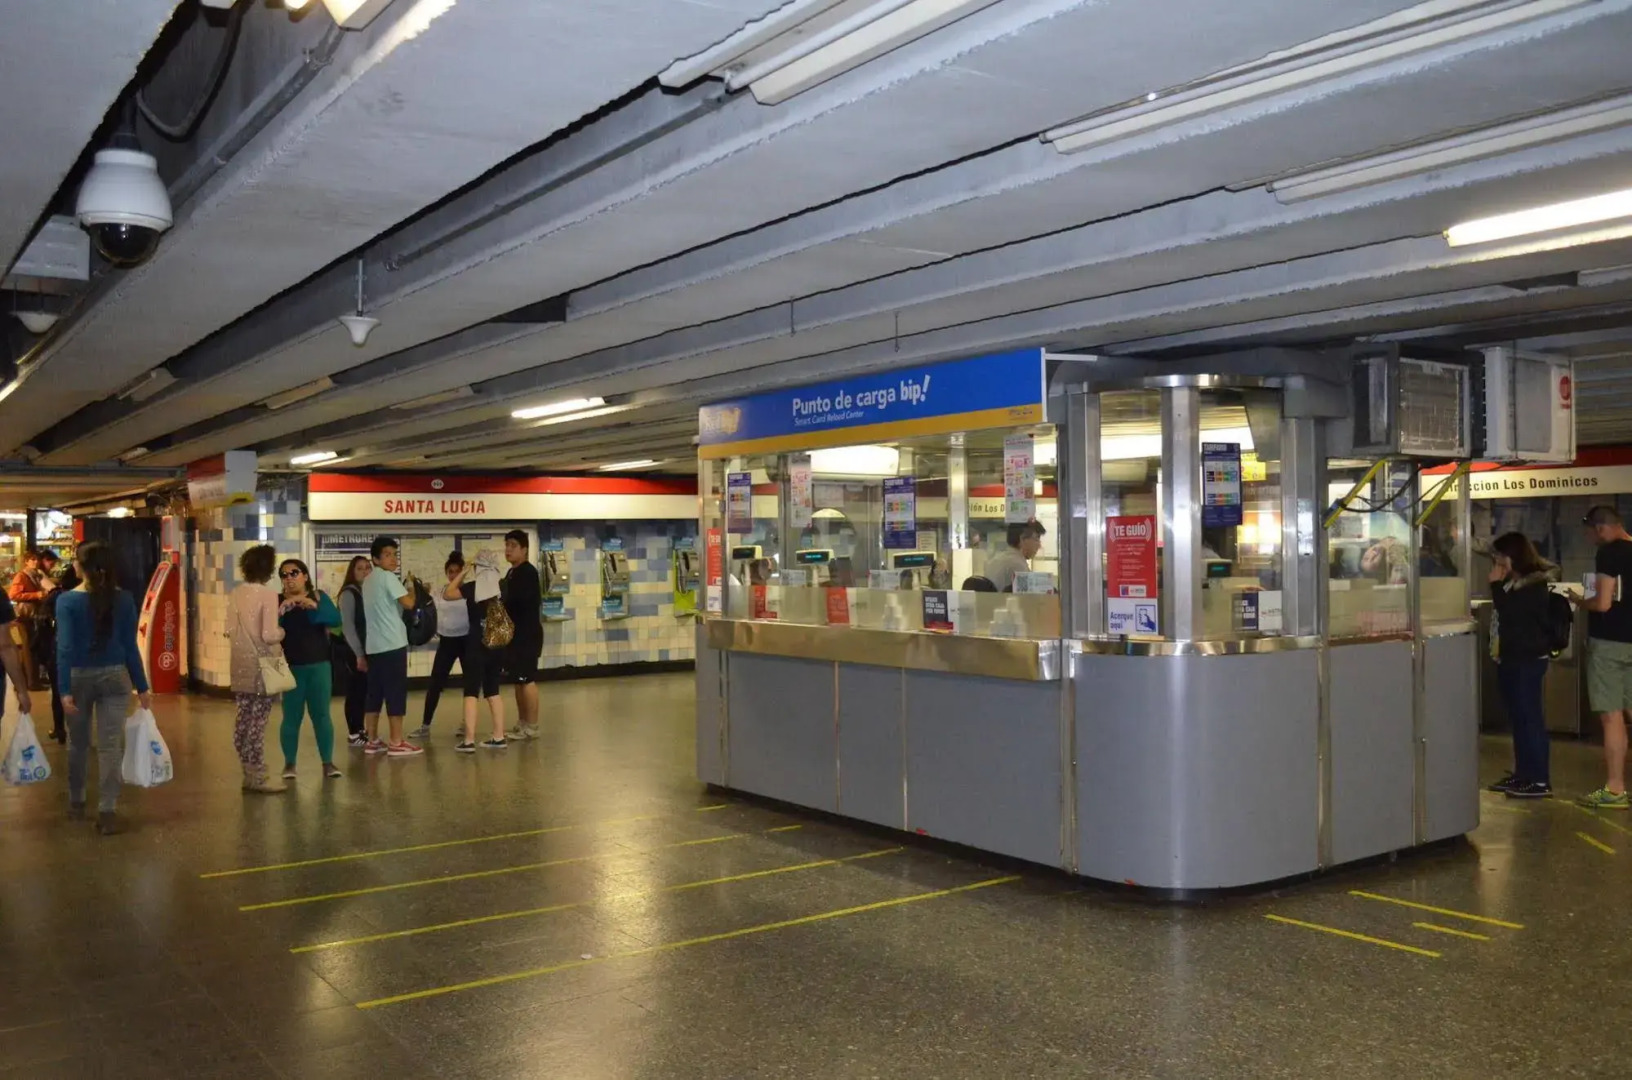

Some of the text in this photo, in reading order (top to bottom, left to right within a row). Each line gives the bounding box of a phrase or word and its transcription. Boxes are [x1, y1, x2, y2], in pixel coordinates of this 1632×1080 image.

[793, 374, 931, 417] Punto de carga bip!
[794, 409, 864, 426] Smart Card Reload Center
[1503, 478, 1525, 490] Los
[1529, 474, 1598, 489] Dominicos
[384, 499, 486, 514] SANTA LUCIA
[1114, 525, 1125, 537] TE
[1110, 611, 1134, 622] Acerque
